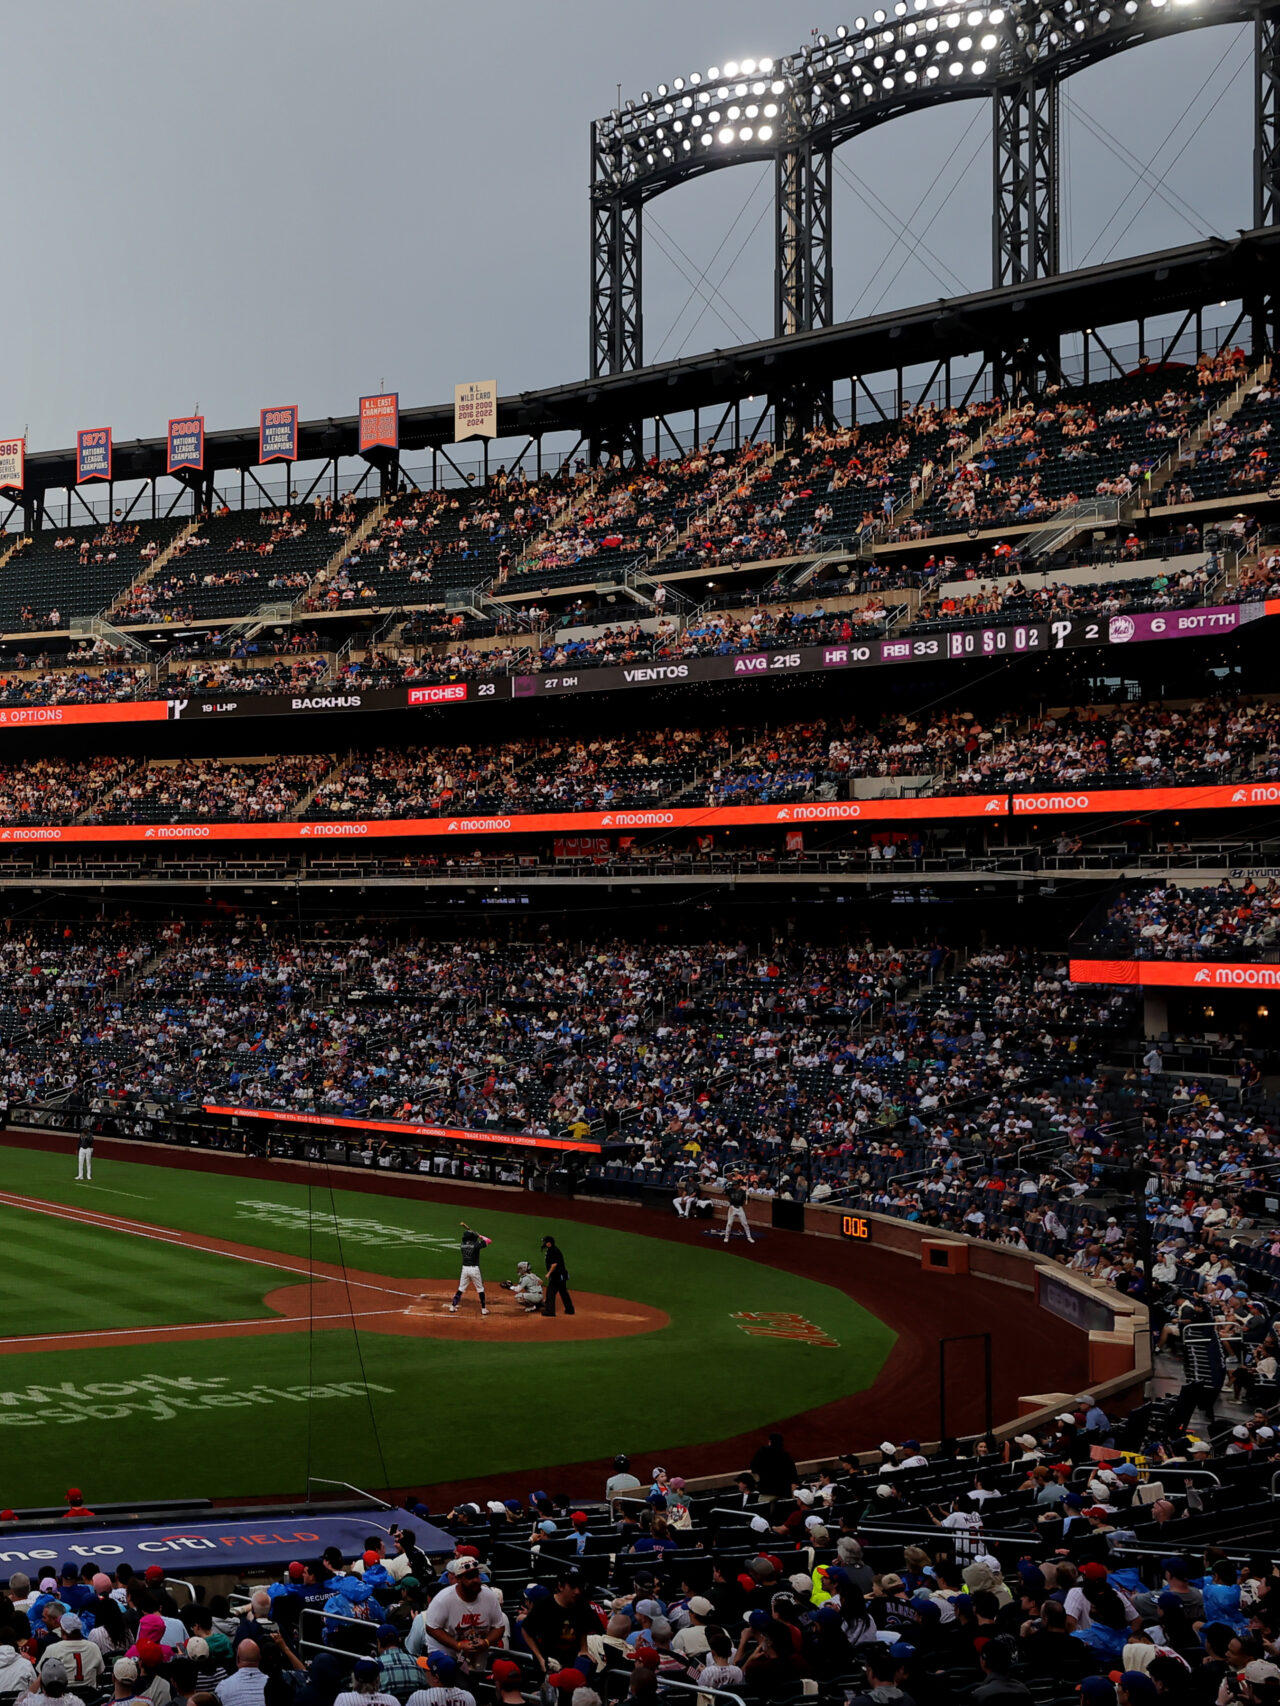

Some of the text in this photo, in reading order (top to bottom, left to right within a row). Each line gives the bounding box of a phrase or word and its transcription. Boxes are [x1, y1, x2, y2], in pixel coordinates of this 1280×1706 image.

[461, 392, 491, 402] WILD CARD
[475, 401, 492, 409] 2000
[362, 406, 394, 416] CHAMPIONS
[459, 409, 492, 419] 2016 2022
[265, 410, 292, 426] 2015
[467, 418, 484, 426] 2024
[171, 421, 200, 436] 2000
[265, 426, 291, 435] NATIONAL
[82, 432, 106, 446] 1973
[173, 436, 198, 446] NATIONAL
[268, 434, 289, 443] LEAGUE
[82, 446, 106, 456] NATIONAL
[175, 445, 195, 453] LEAGUE
[263, 441, 293, 451] CHAMPIONS
[84, 455, 104, 463] LEAGUE
[170, 451, 200, 461] CHAMPIONS
[0, 458, 15, 466] WORLD
[80, 462, 108, 472] CHAMPIONS
[0, 466, 16, 474] SERIES
[1085, 625, 1099, 639] 2
[1150, 618, 1166, 633] 6
[1178, 616, 1207, 630] BOT
[1209, 613, 1236, 628] 7TH
[545, 641, 939, 688] 27 DH VIENTOS AVG .215 HR 10 RBI 33
[202, 683, 495, 713] 19 LHP BACKHUS PITCHES 23
[0, 711, 7, 722] &
[10, 709, 63, 722] OPTIONS
[1005, 796, 1089, 810] moomoo
[793, 805, 860, 819] moomoo
[615, 812, 674, 825] moomoo
[313, 823, 368, 835] moomoo
[459, 818, 511, 831] moomoo
[13, 828, 61, 840] moomoo
[156, 827, 209, 838] moomoo
[843, 1216, 868, 1238] 006
[69, 1543, 125, 1556] to
[138, 1535, 216, 1554] citi
[220, 1531, 320, 1548] FIELD
[461, 1614, 481, 1625] NIKE
[73, 1652, 84, 1681] 1
